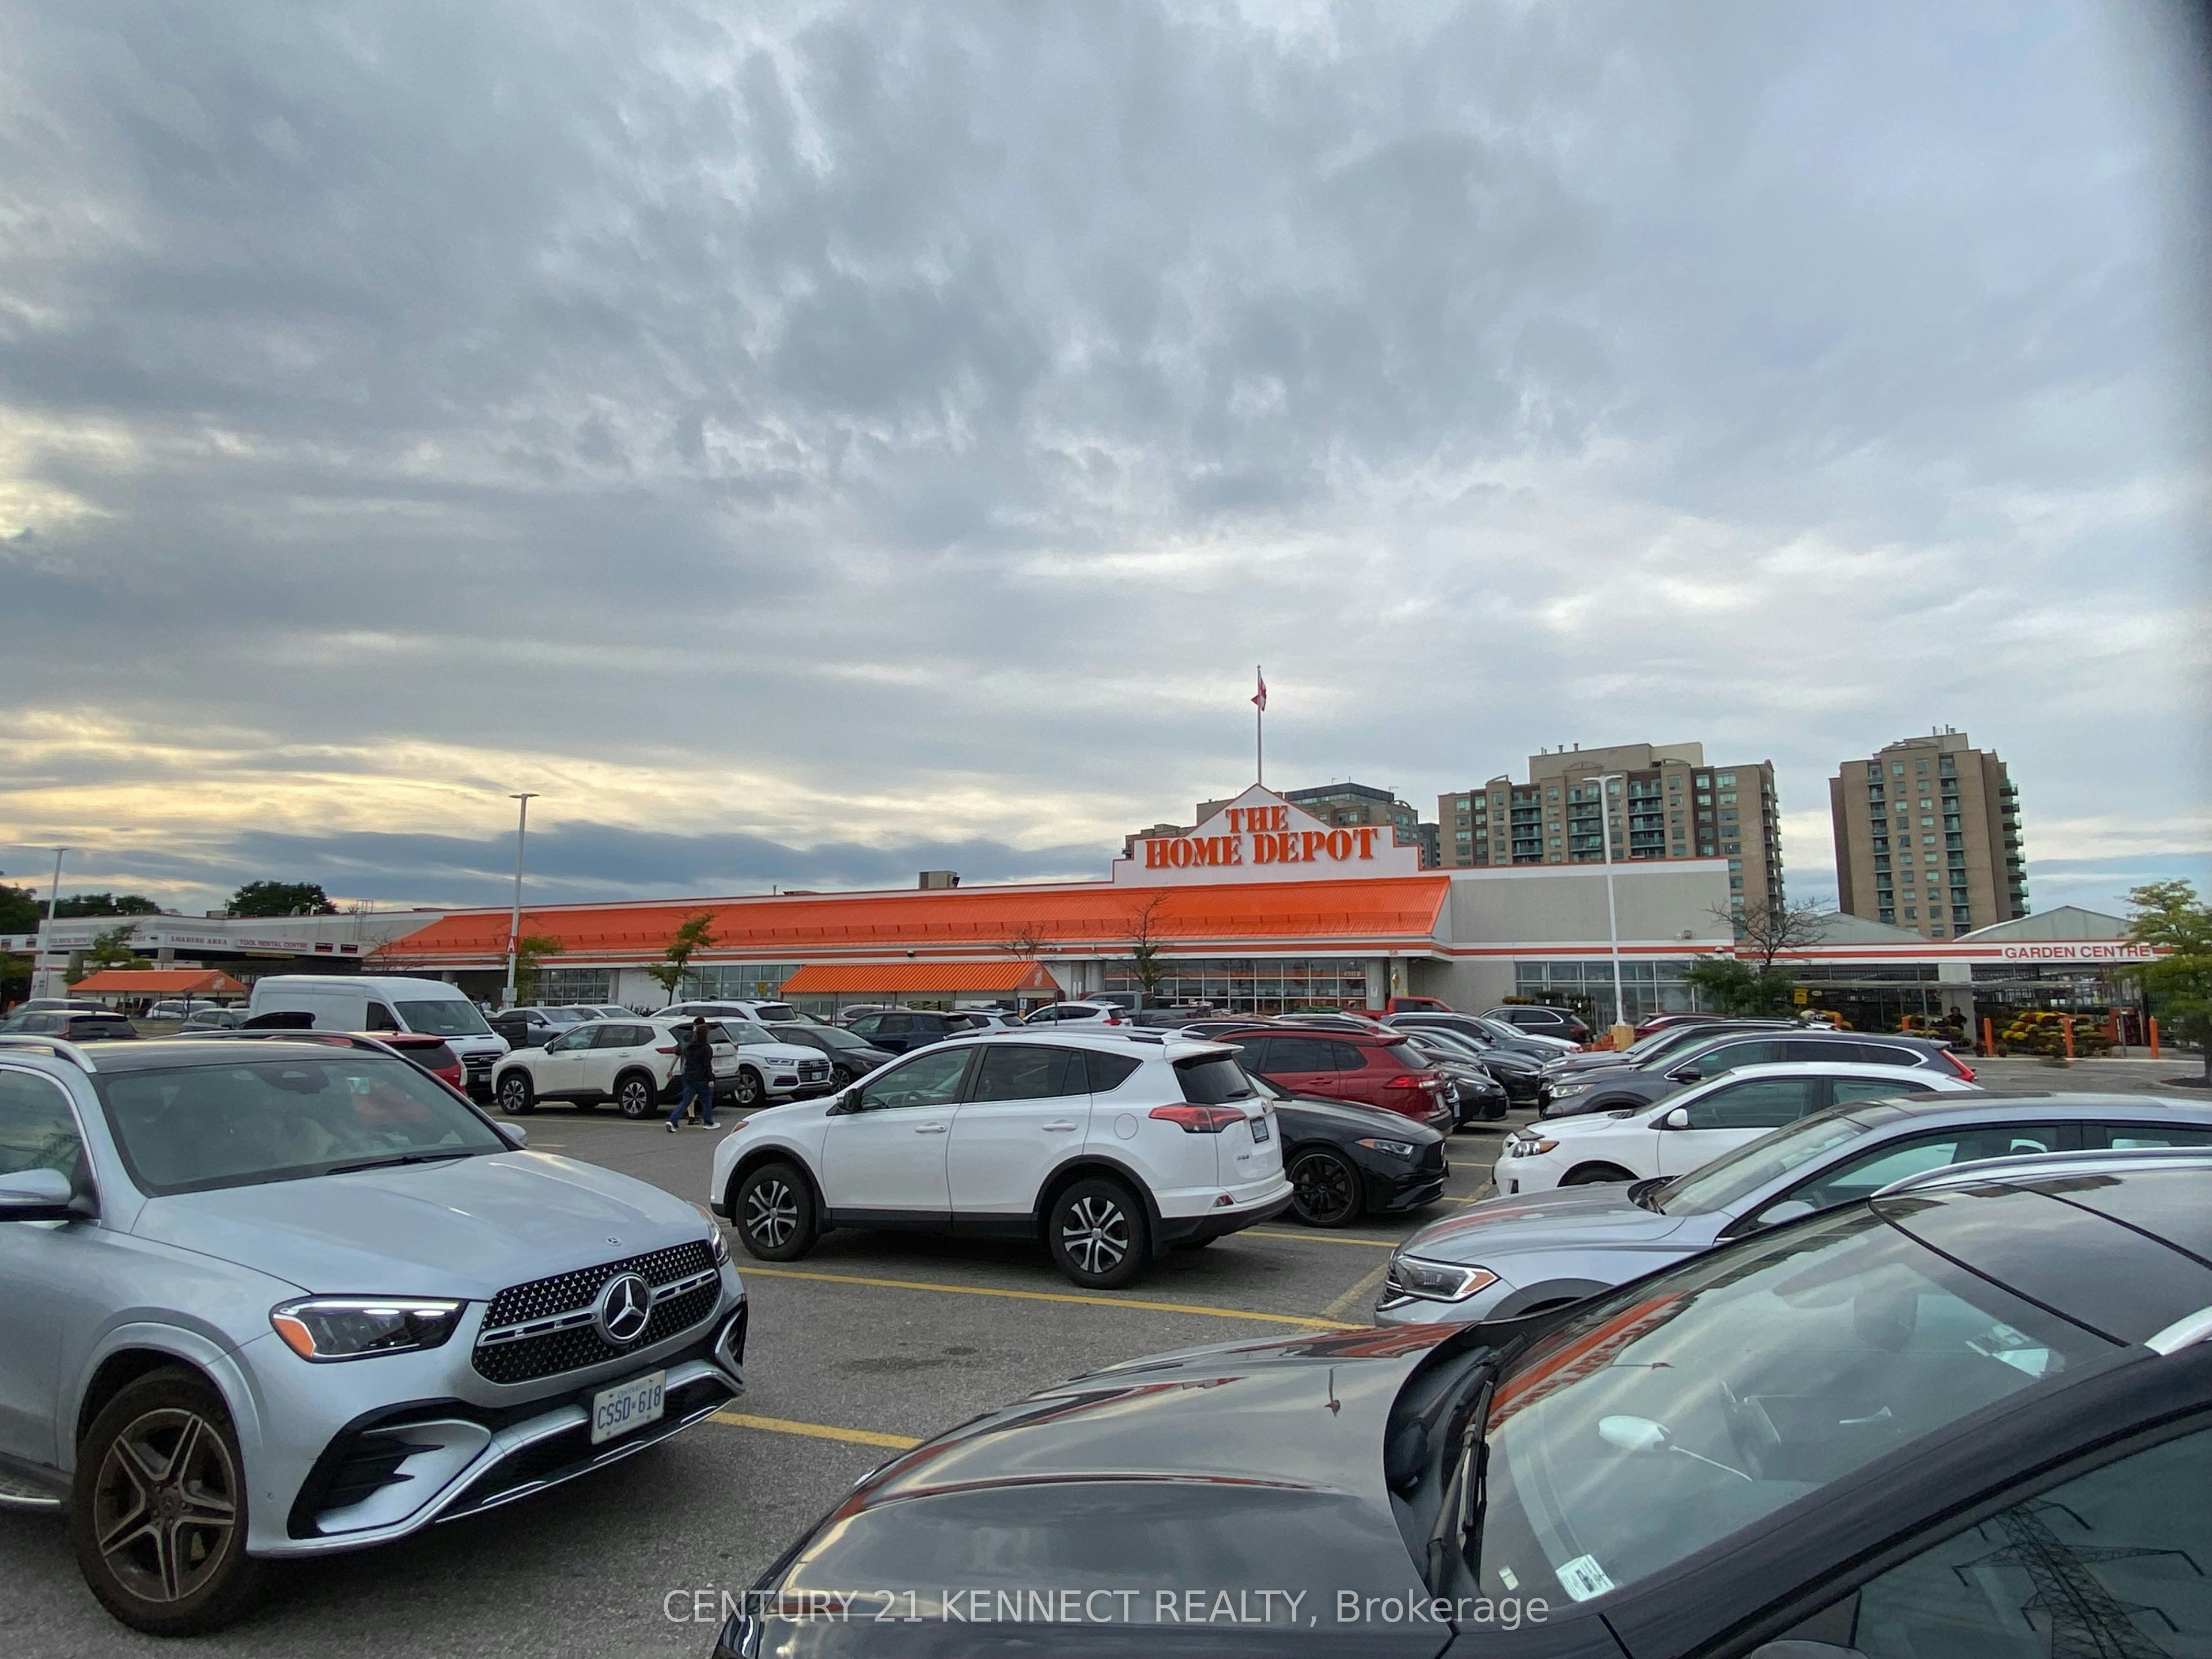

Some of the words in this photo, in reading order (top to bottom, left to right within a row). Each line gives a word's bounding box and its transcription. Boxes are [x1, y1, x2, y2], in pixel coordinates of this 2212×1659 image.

[1225, 805, 1289, 833] THE
[1145, 835, 1243, 869] HOME
[1253, 828, 1378, 863] DEPOT
[171, 935, 204, 944] LOADING
[507, 937, 515, 952] A
[2005, 946, 2075, 959] GARDEN
[2081, 945, 2150, 958] CENTRE
